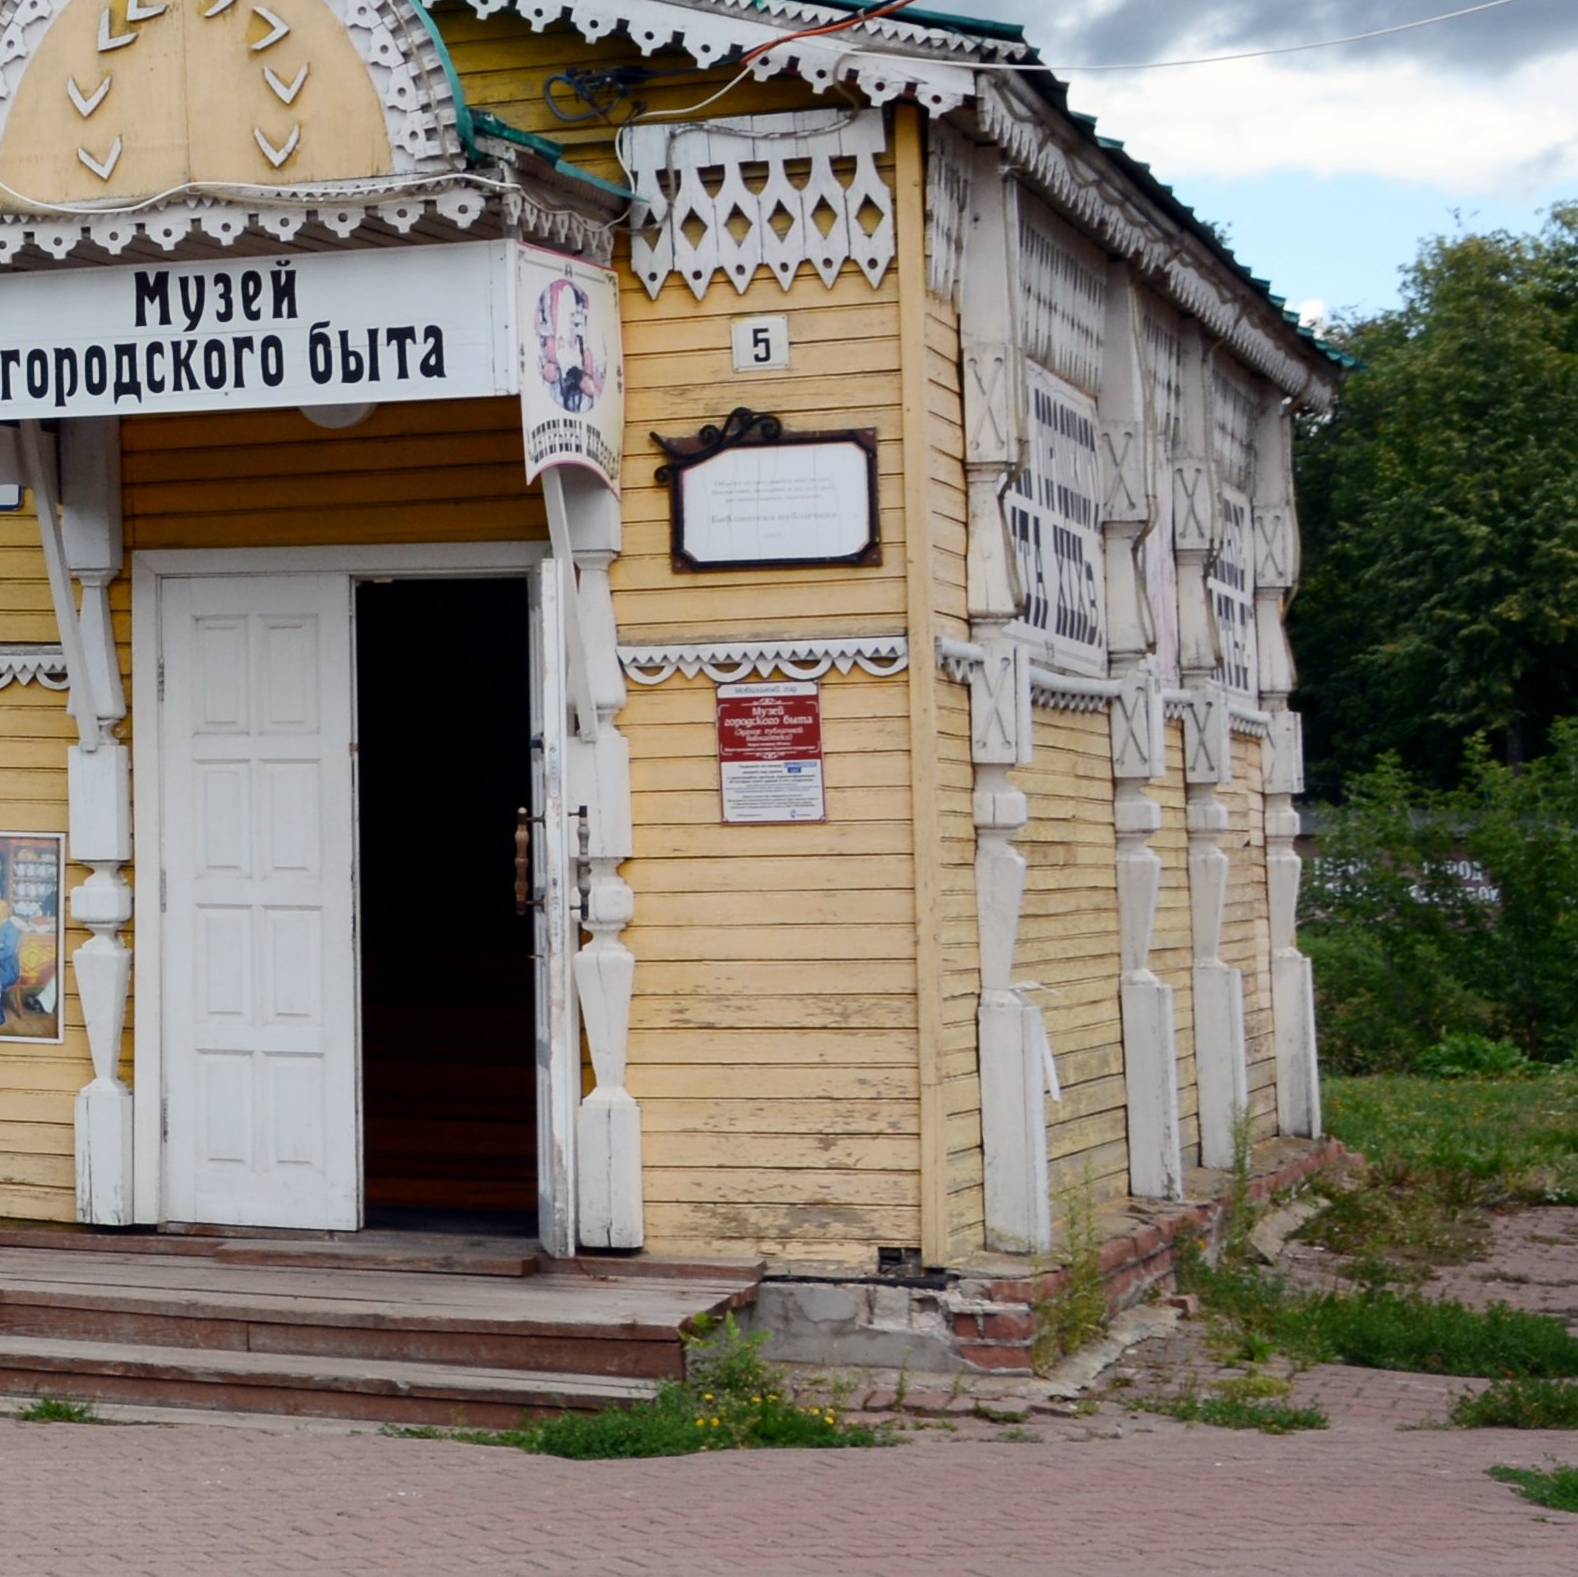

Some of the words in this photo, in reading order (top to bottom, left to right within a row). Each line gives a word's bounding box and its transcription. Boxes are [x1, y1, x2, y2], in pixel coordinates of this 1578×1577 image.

[134, 260, 298, 331] Музей
[753, 328, 771, 362] 5
[0, 334, 284, 407] городского
[309, 321, 446, 385] быта
[724, 716, 780, 728] городского
[783, 715, 813, 725] быта
[752, 706, 785, 717] Музей
